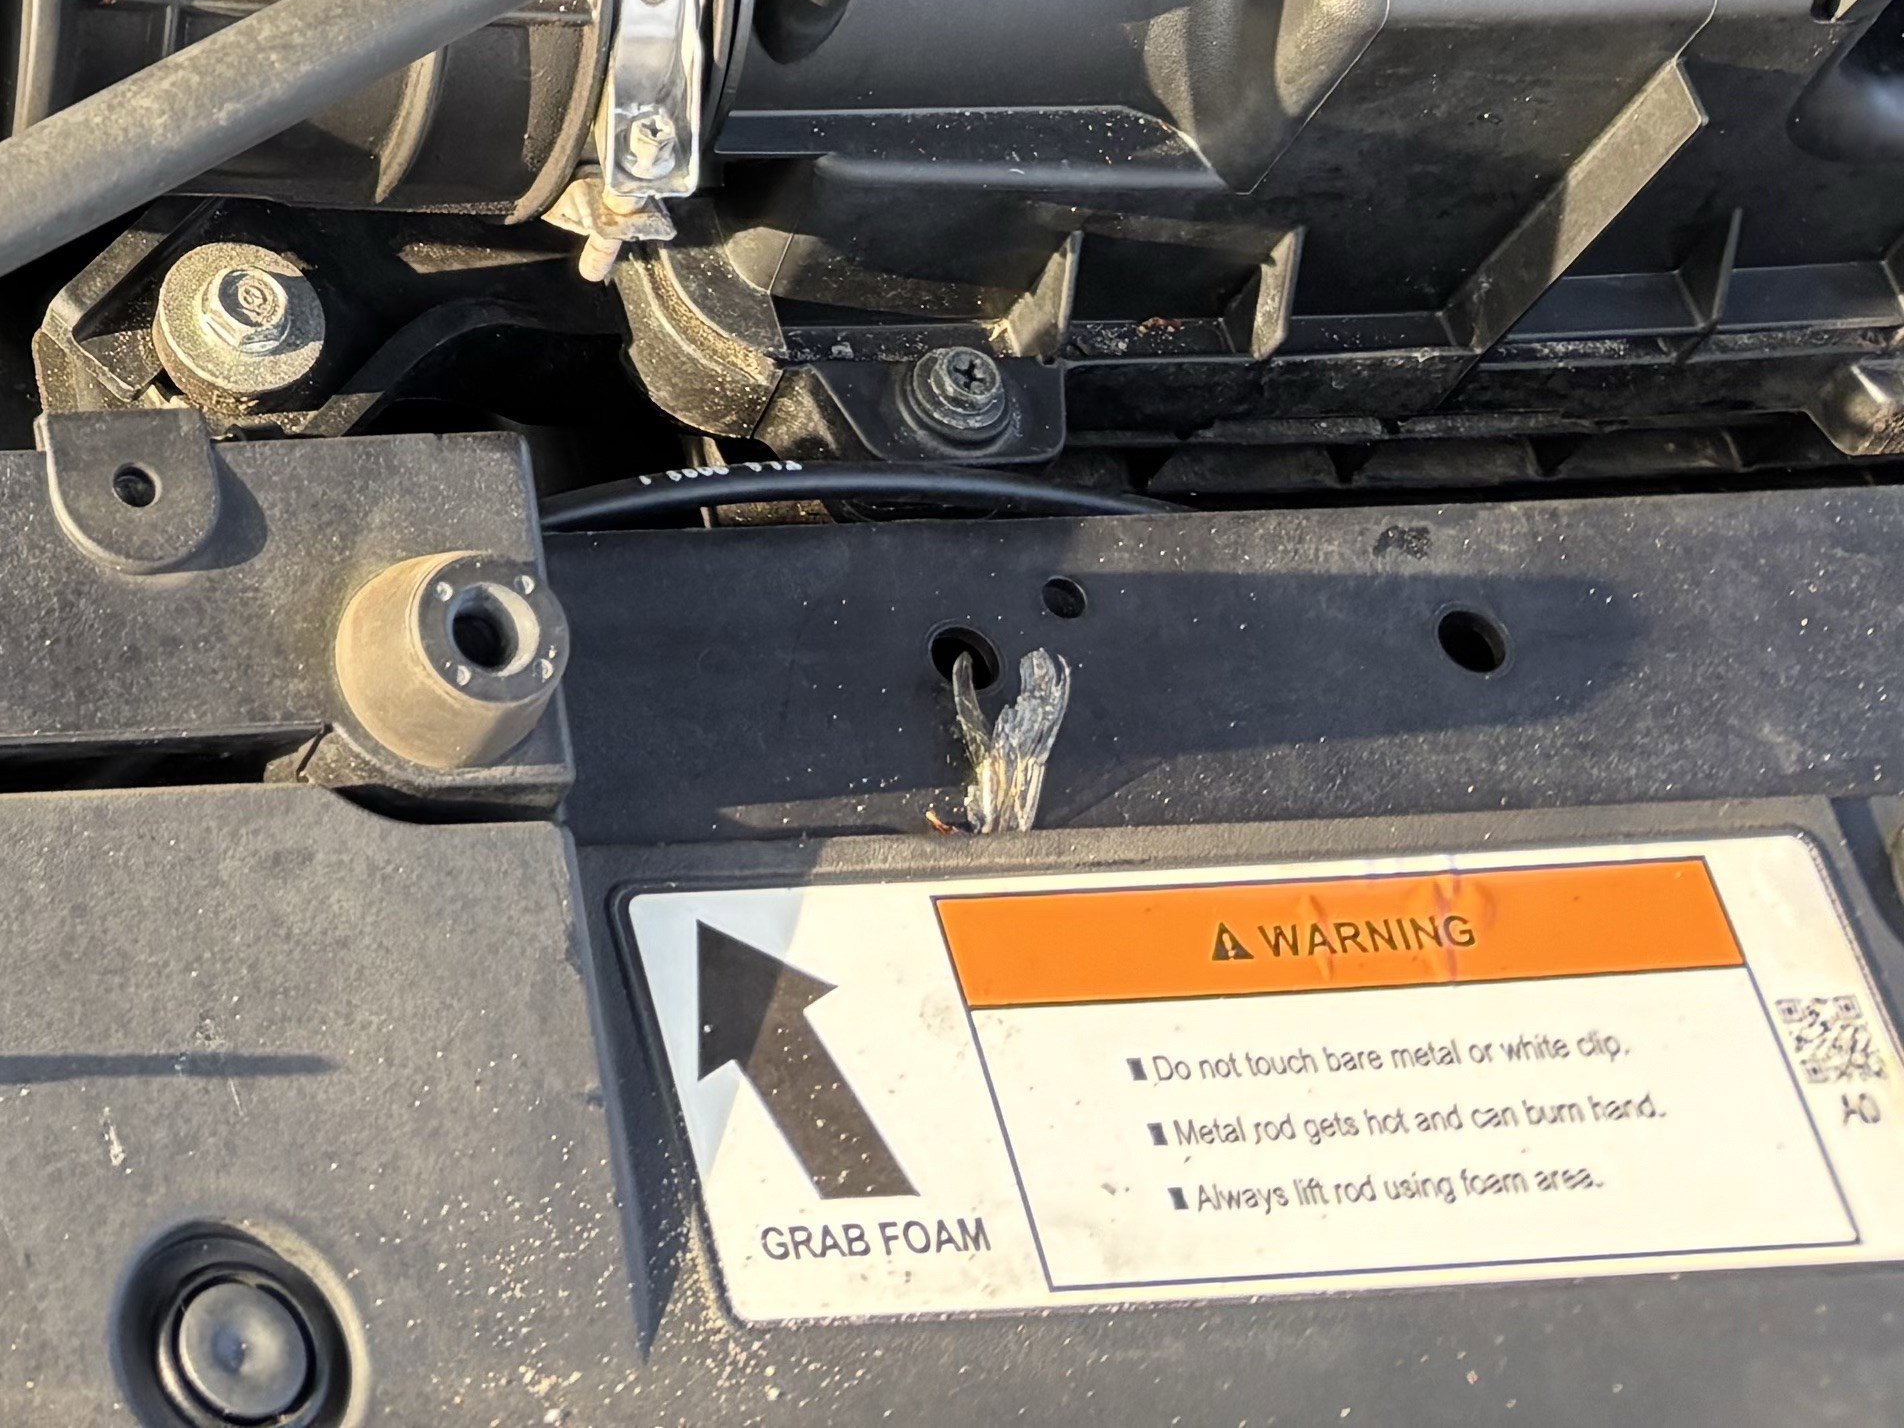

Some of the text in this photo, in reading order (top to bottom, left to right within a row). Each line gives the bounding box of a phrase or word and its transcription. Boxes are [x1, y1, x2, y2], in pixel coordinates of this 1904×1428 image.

[1257, 914, 1477, 958] WARNING
[1154, 1030, 1631, 1083] Do not touch bare metal or white clip.
[1174, 1116, 1246, 1147] Metal
[1253, 1113, 1296, 1146] rod
[1304, 1111, 1361, 1147] gets
[1366, 1108, 1410, 1137] hot
[1416, 1103, 1464, 1133] and
[1470, 1103, 1518, 1130] can
[1589, 1092, 1667, 1122] hand.
[1197, 1164, 1604, 1216] Always lift rod using foam area.
[760, 1216, 992, 1261] GRAB FOAM
